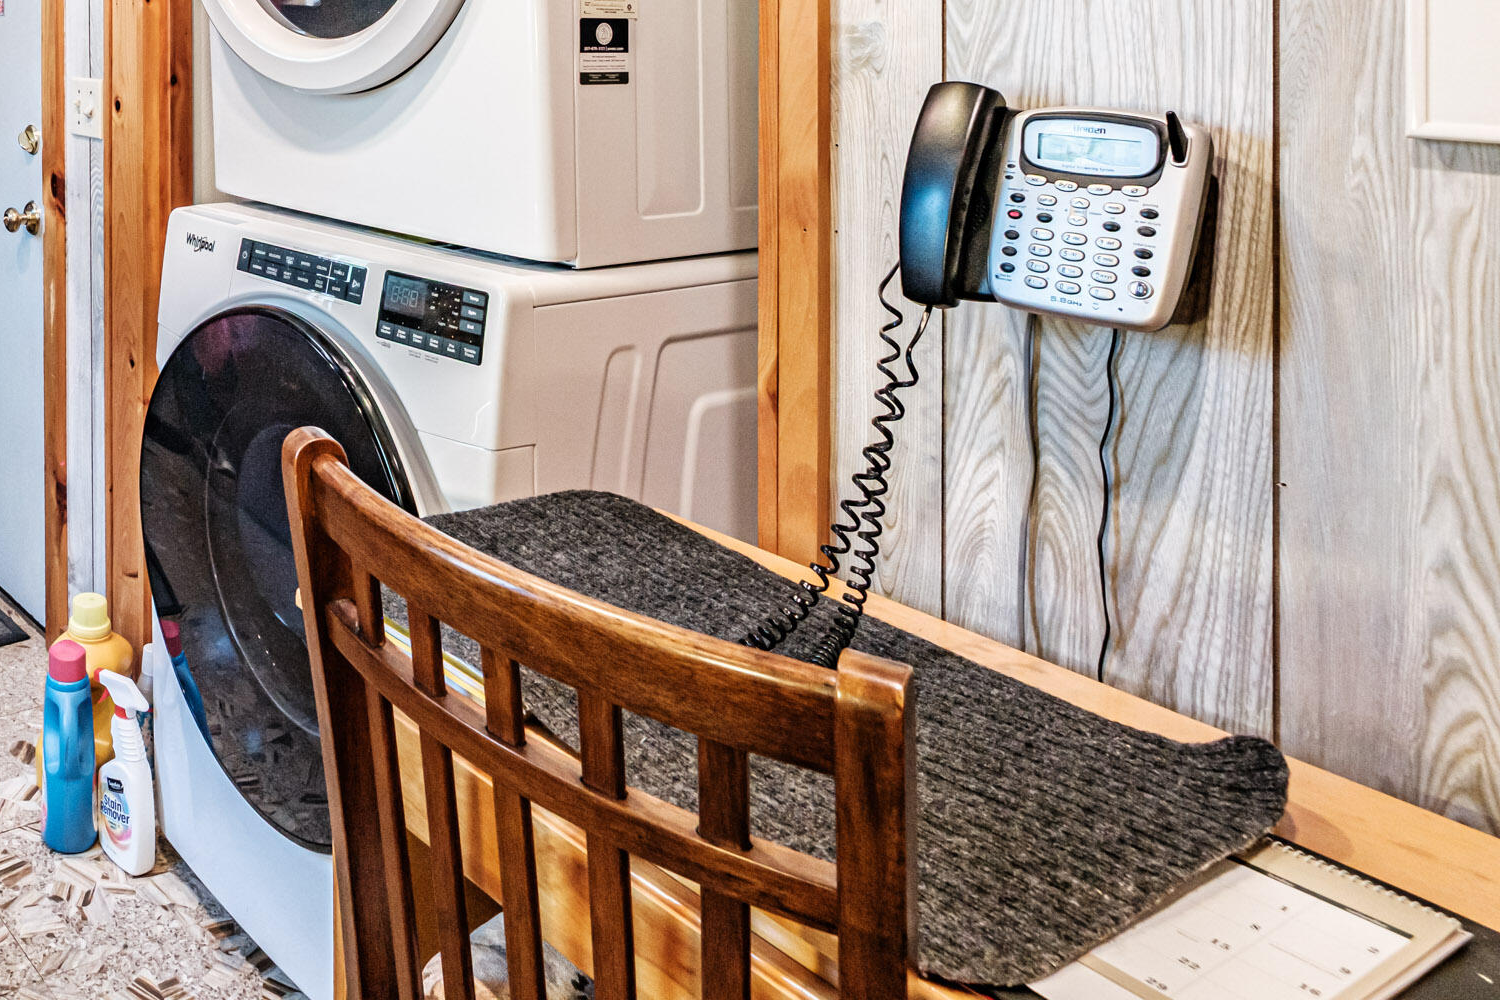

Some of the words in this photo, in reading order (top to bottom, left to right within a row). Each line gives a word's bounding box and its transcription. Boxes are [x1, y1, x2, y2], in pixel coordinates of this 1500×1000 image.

[186, 231, 215, 252] Whirlpool
[100, 801, 130, 825] Remover
[104, 794, 122, 812] Stain
